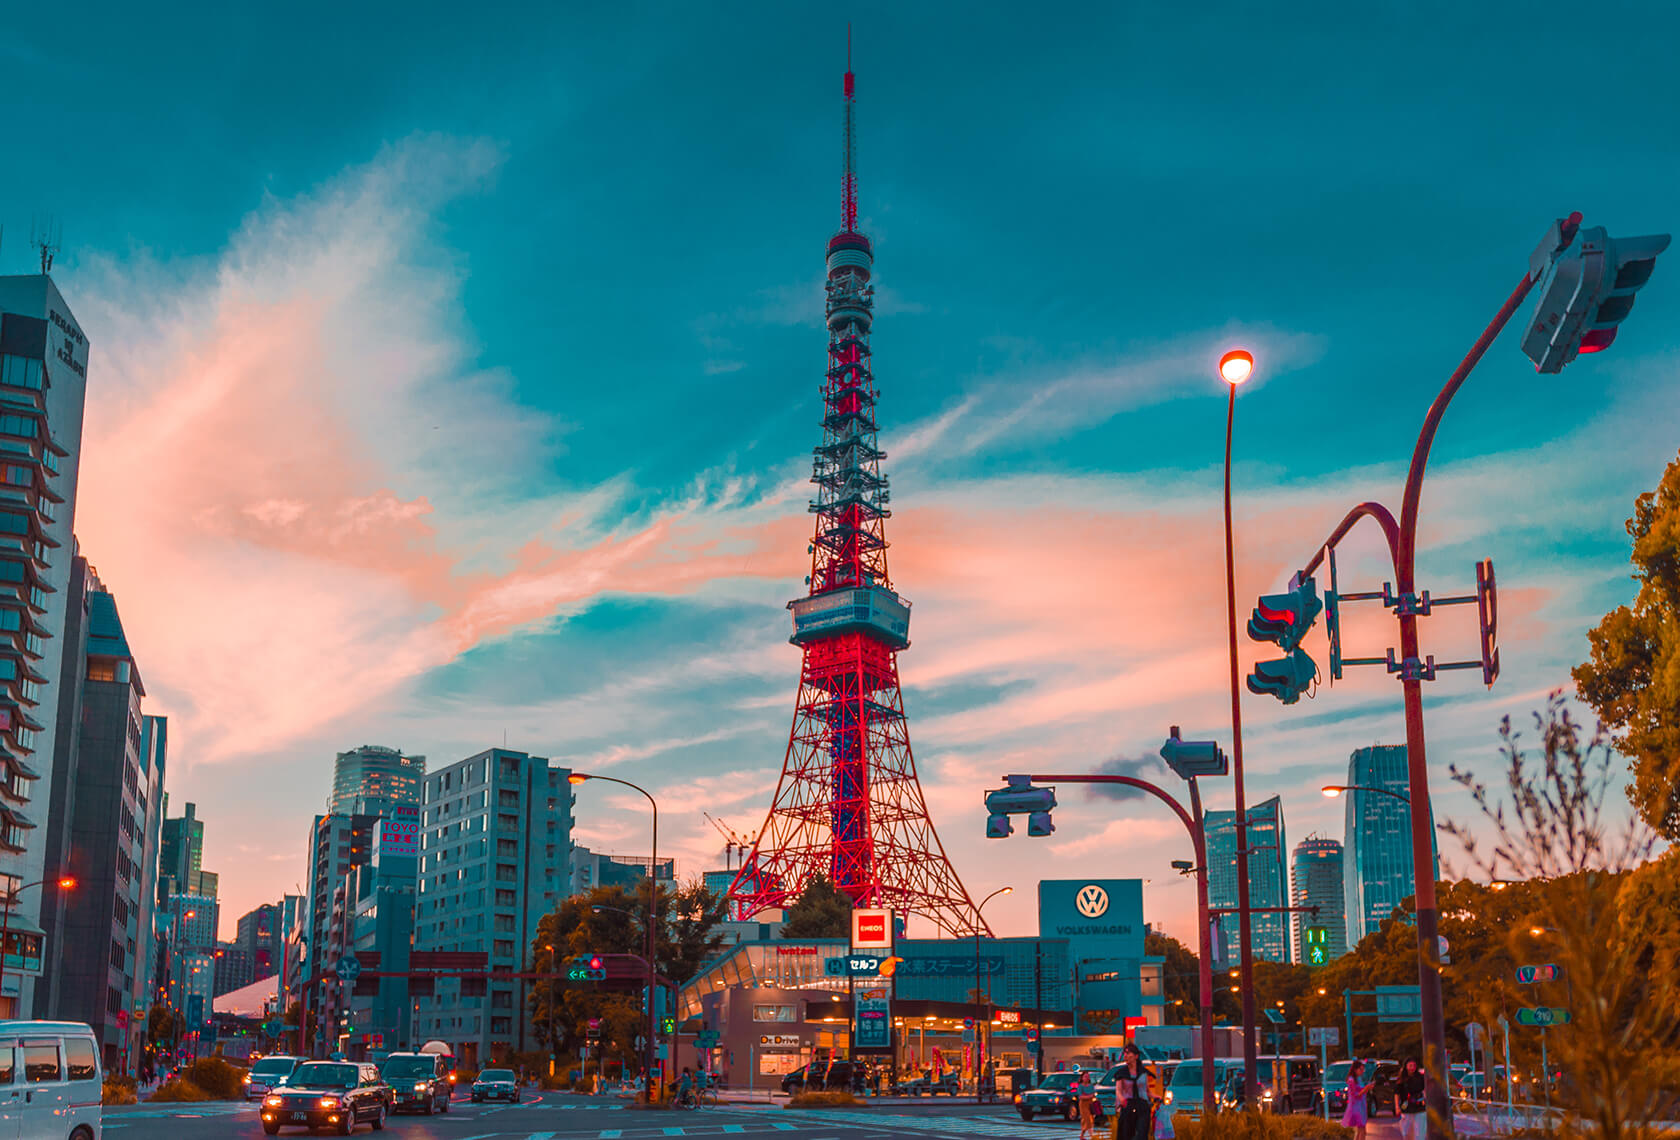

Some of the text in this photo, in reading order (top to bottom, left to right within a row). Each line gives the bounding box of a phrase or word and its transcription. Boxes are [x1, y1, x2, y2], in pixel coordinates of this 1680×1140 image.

[49, 309, 82, 344] SERAPH
[383, 822, 418, 833] TOYO
[1056, 925, 1132, 936] VOLKSWAGEN
[776, 945, 818, 956] Iwatani
[850, 959, 878, 970] セルフ
[896, 959, 1002, 974] 水素ステーション
[1000, 1012, 1018, 1022] ENEOS
[775, 1036, 799, 1044] Drive
